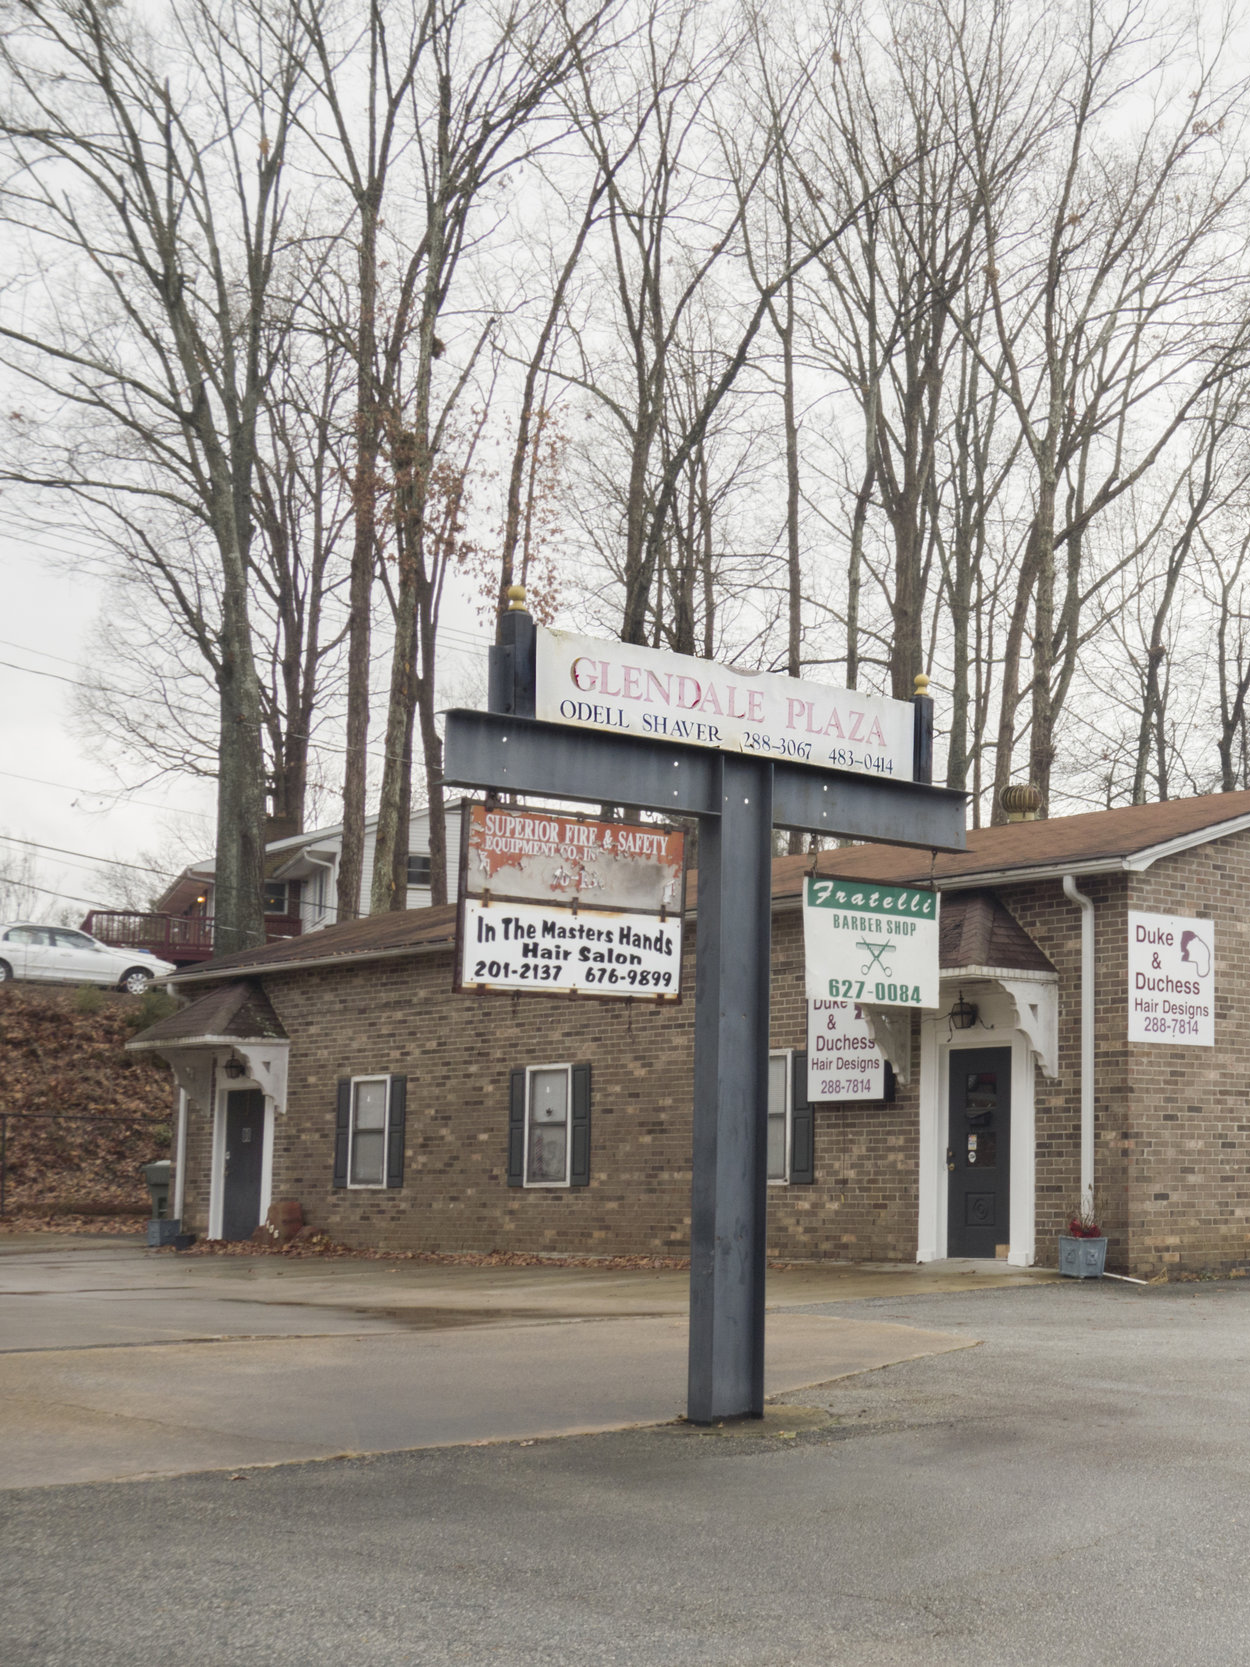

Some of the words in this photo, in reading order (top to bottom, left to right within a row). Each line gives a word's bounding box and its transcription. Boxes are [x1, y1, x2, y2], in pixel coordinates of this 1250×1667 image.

[570, 656, 765, 723] GLENDALE
[785, 697, 888, 747] PLAZA
[560, 700, 630, 728] ODELL
[642, 713, 722, 743] SHAVER
[743, 731, 812, 760] 288-3067
[828, 748, 893, 775] 483-0414
[485, 813, 559, 842] SUPERIOR
[603, 829, 613, 849] &
[618, 831, 668, 856] SAFETY
[485, 835, 557, 857] EQUIPMENT
[812, 881, 932, 913] Fratelli
[477, 916, 495, 943] In
[501, 917, 536, 941] The
[542, 919, 613, 944] Masters
[619, 926, 673, 956] Hands
[833, 914, 882, 933] BARBER
[886, 920, 916, 937] SHOP
[1136, 925, 1174, 946] Duke
[522, 942, 572, 961] Hair
[578, 946, 642, 965] Salon
[1151, 952, 1162, 970] &
[474, 961, 562, 981] 201-2137
[585, 966, 672, 987] 676-9899
[1135, 972, 1200, 995] Duchess
[828, 979, 922, 1004] 627-0084
[1135, 997, 1159, 1013] Hair
[1162, 1000, 1209, 1020] Designs
[826, 1014, 837, 1030] &
[1144, 1016, 1199, 1035] 288-7814
[816, 1034, 875, 1052] Duchess
[812, 1057, 833, 1071] Hair
[836, 1056, 880, 1073] Designs
[821, 1078, 871, 1094] 288-7814
